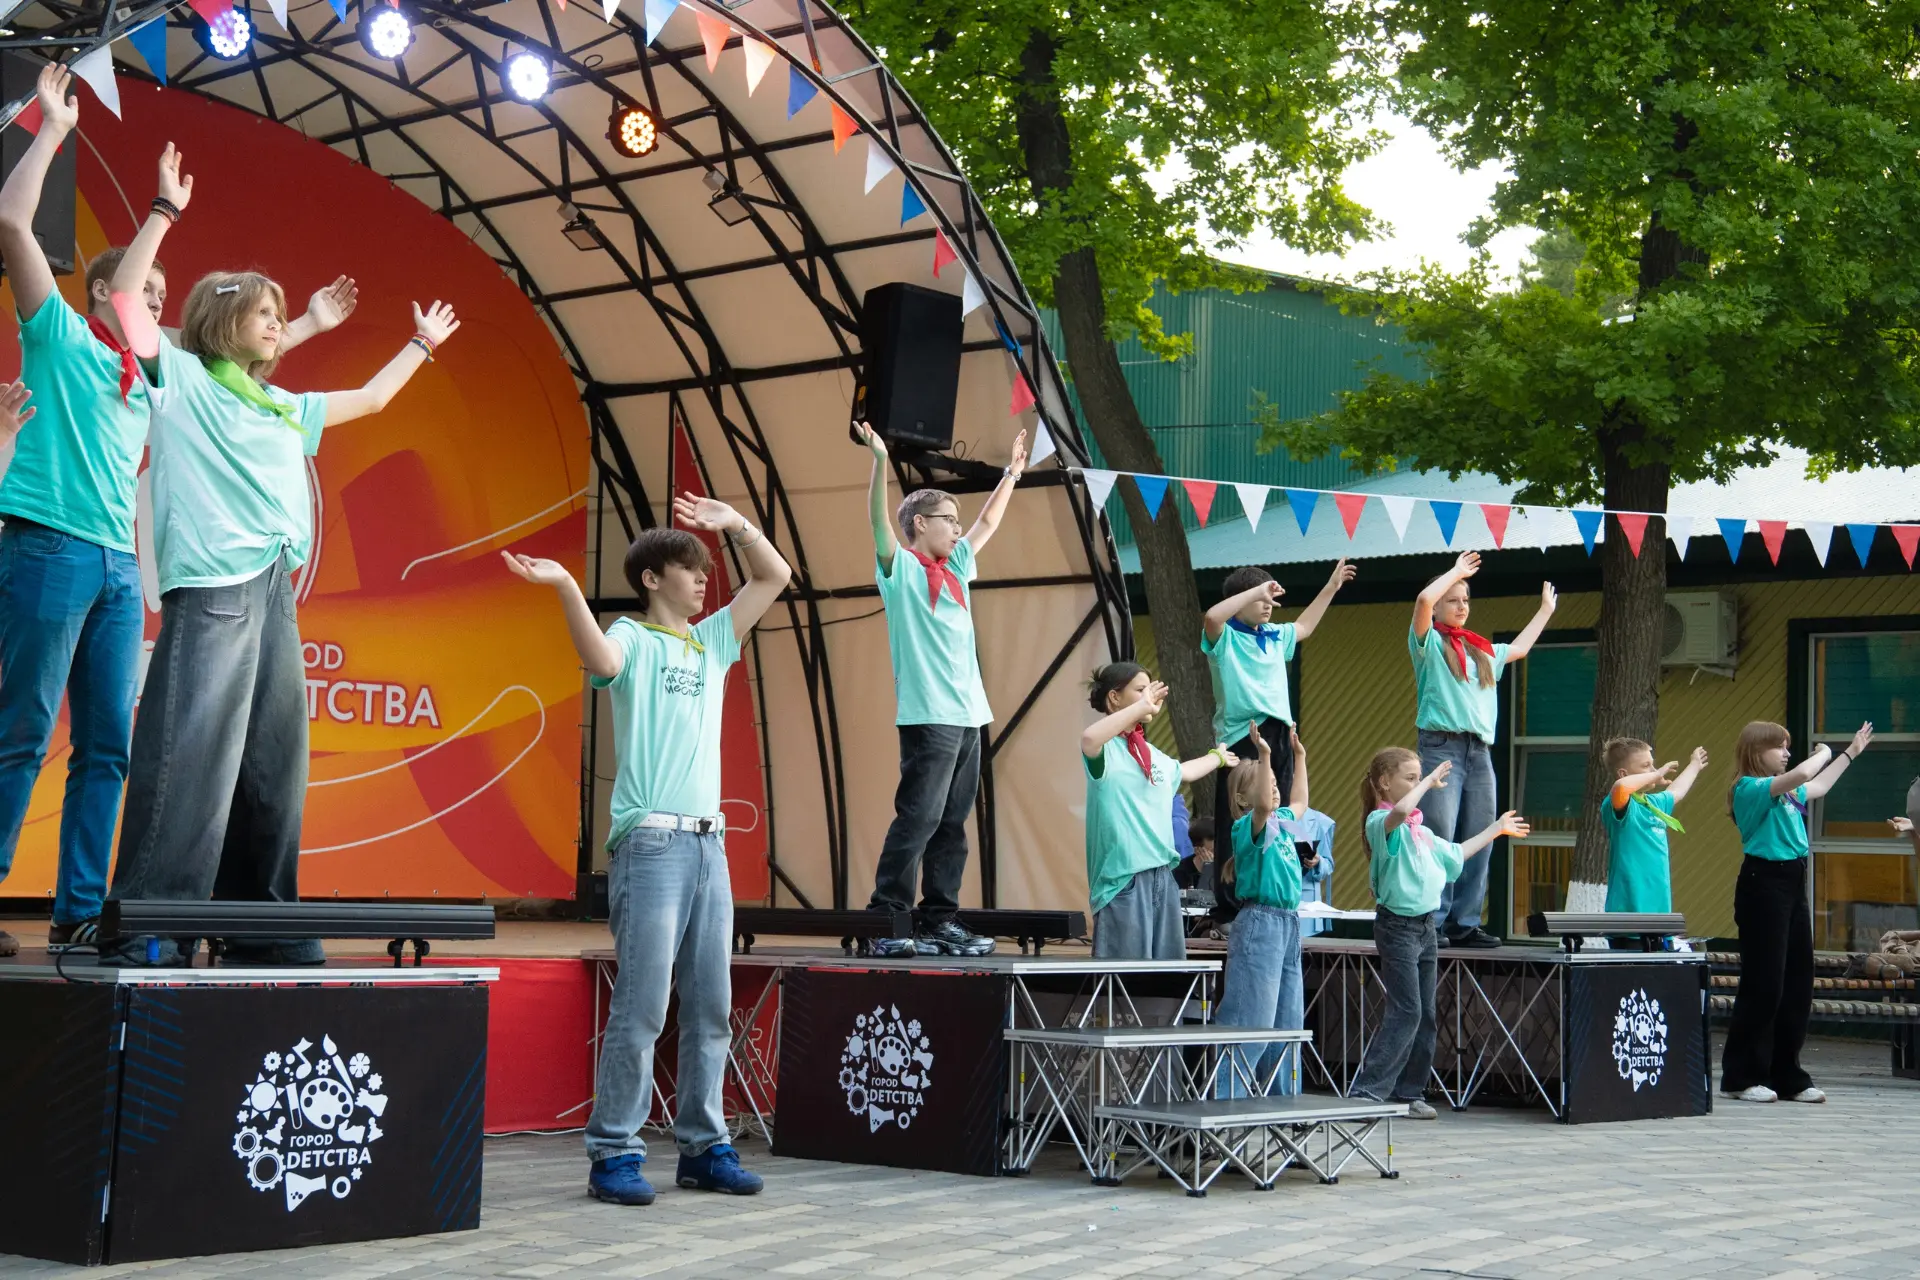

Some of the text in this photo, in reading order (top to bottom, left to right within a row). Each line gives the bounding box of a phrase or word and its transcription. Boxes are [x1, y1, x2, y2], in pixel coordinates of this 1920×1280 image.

[305, 678, 440, 727] ТСТВА
[870, 1088, 924, 1105] DЕТСТВА
[290, 1134, 333, 1148] ГОРОD
[286, 1147, 372, 1169] DЕТСТВА
